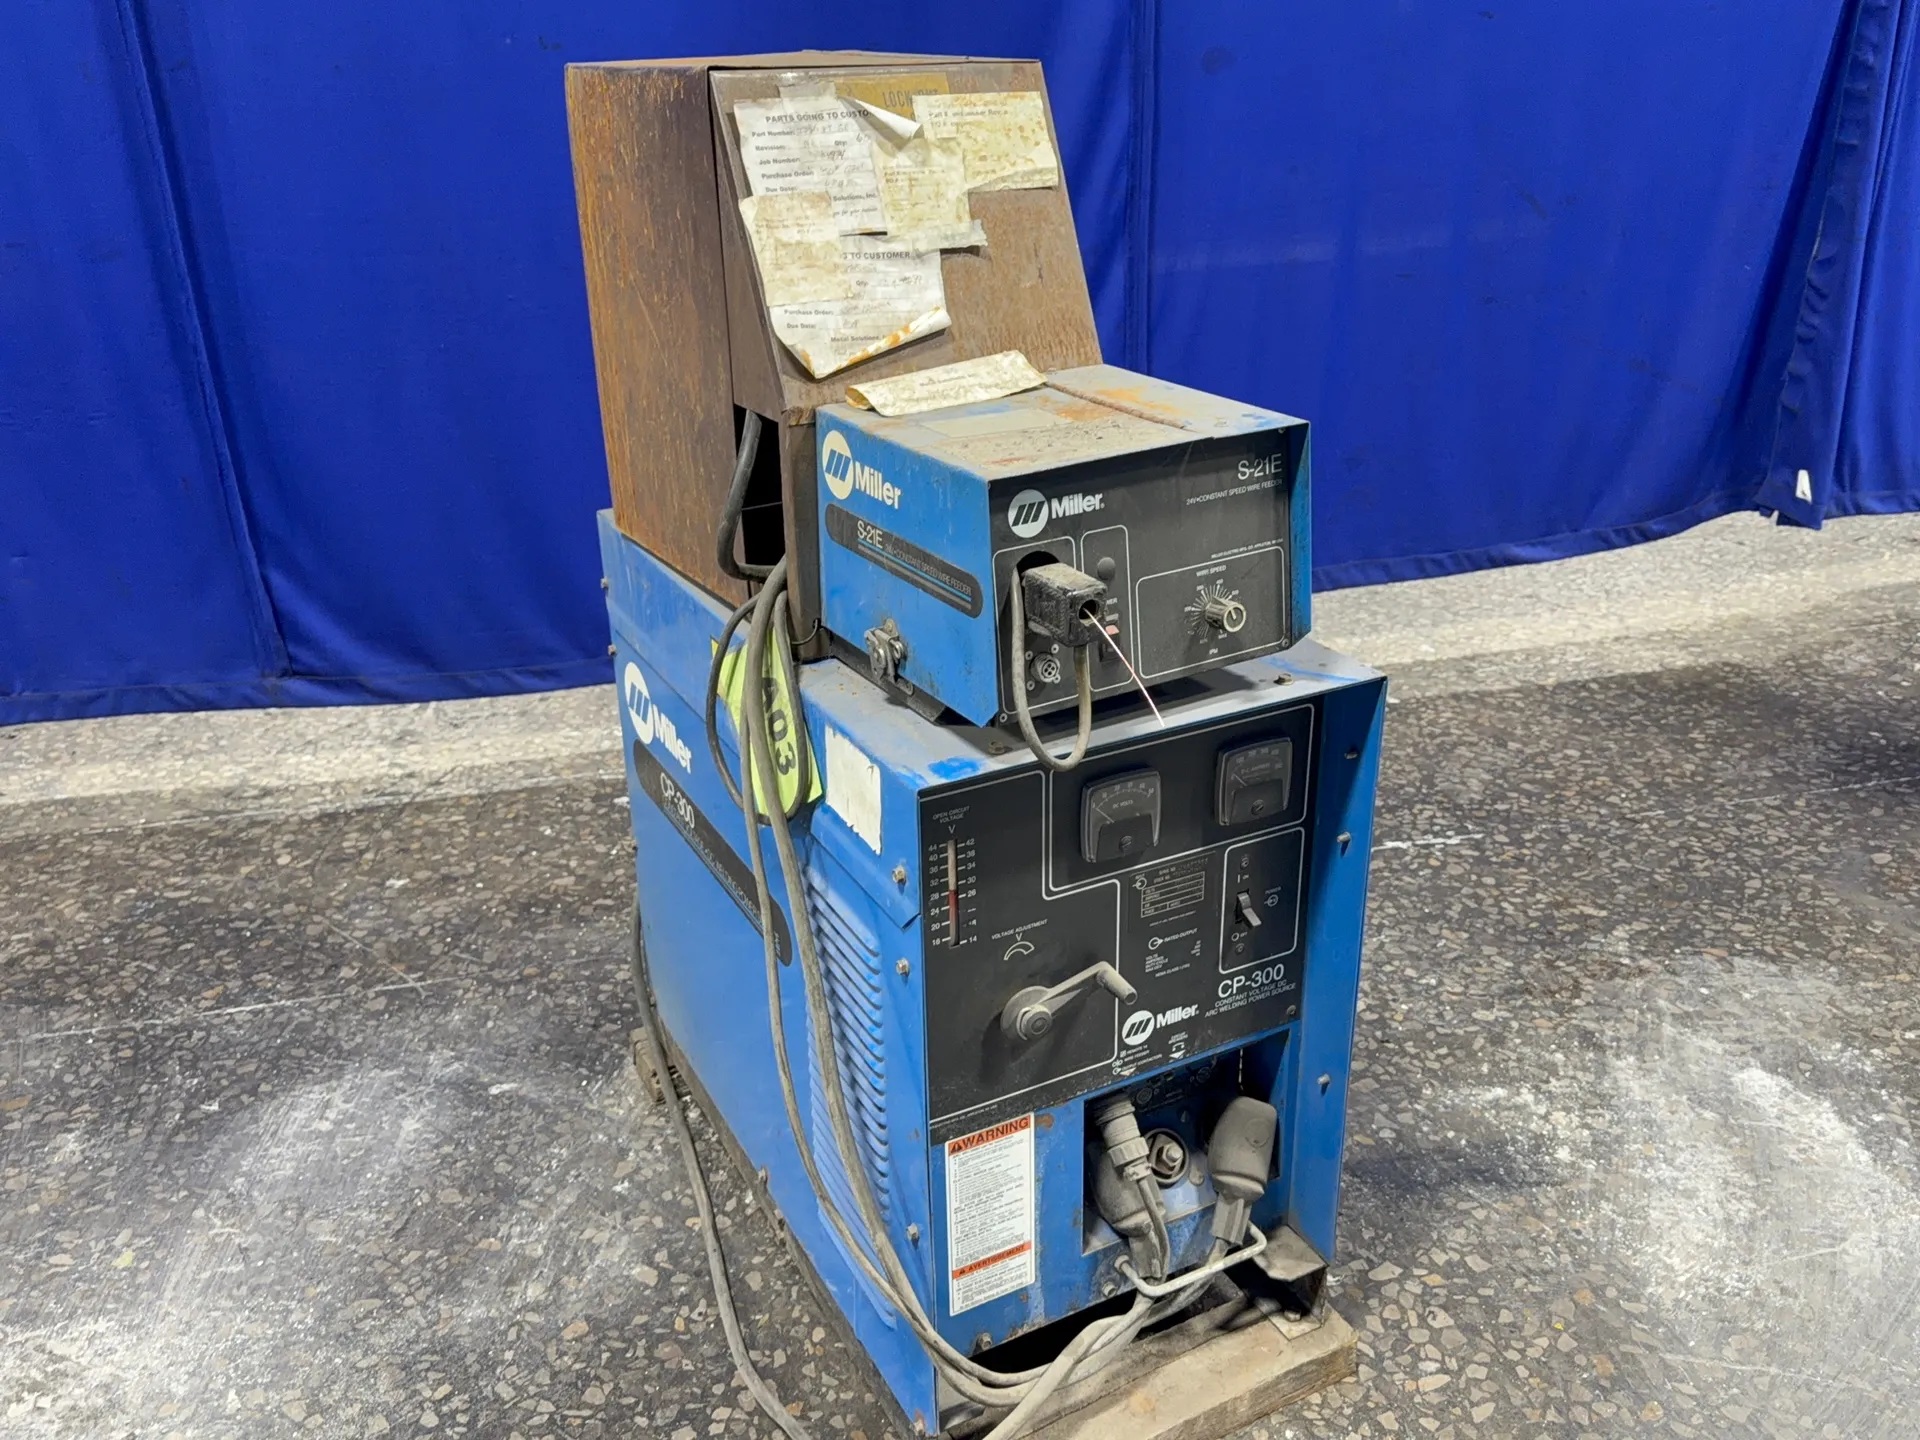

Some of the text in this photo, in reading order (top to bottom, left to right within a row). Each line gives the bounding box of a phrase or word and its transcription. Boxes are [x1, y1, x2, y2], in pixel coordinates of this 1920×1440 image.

[765, 109, 874, 123] PARTS GOING TO CUSTO
[761, 170, 814, 180] Purchase Order:
[851, 252, 862, 260] TO
[864, 252, 911, 260] CUSTOMER
[1237, 453, 1282, 480] S-21E
[856, 461, 901, 509] Miller
[1229, 486, 1247, 496] SPEED
[1051, 492, 1104, 519] Miller
[857, 520, 883, 548] S-21E
[1210, 565, 1227, 575] SPEED
[652, 704, 692, 774] Miller
[660, 772, 696, 829] CP-300
[933, 811, 948, 820] OPEN
[940, 813, 964, 824] VOLTAGE
[948, 825, 955, 834] V
[966, 838, 975, 846] 42
[929, 854, 938, 862] 40
[929, 865, 939, 874] 36
[966, 862, 976, 870] 34
[930, 879, 939, 887] 32
[967, 876, 976, 884] 30
[930, 892, 939, 901] 28
[967, 889, 976, 898] 26
[930, 907, 940, 916] 24
[931, 923, 940, 931] 20
[991, 929, 1014, 940] VOLTAGE
[1016, 933, 1023, 942] V
[932, 938, 941, 946] 16
[1218, 964, 1285, 999] CP-300
[1215, 979, 1287, 1008] CONSTANT VOLTAGE DC
[1205, 983, 1296, 1018] ARC WELDING POWER SOURCE
[1156, 1004, 1198, 1029] Miller
[962, 1117, 1028, 1148] WARNING
